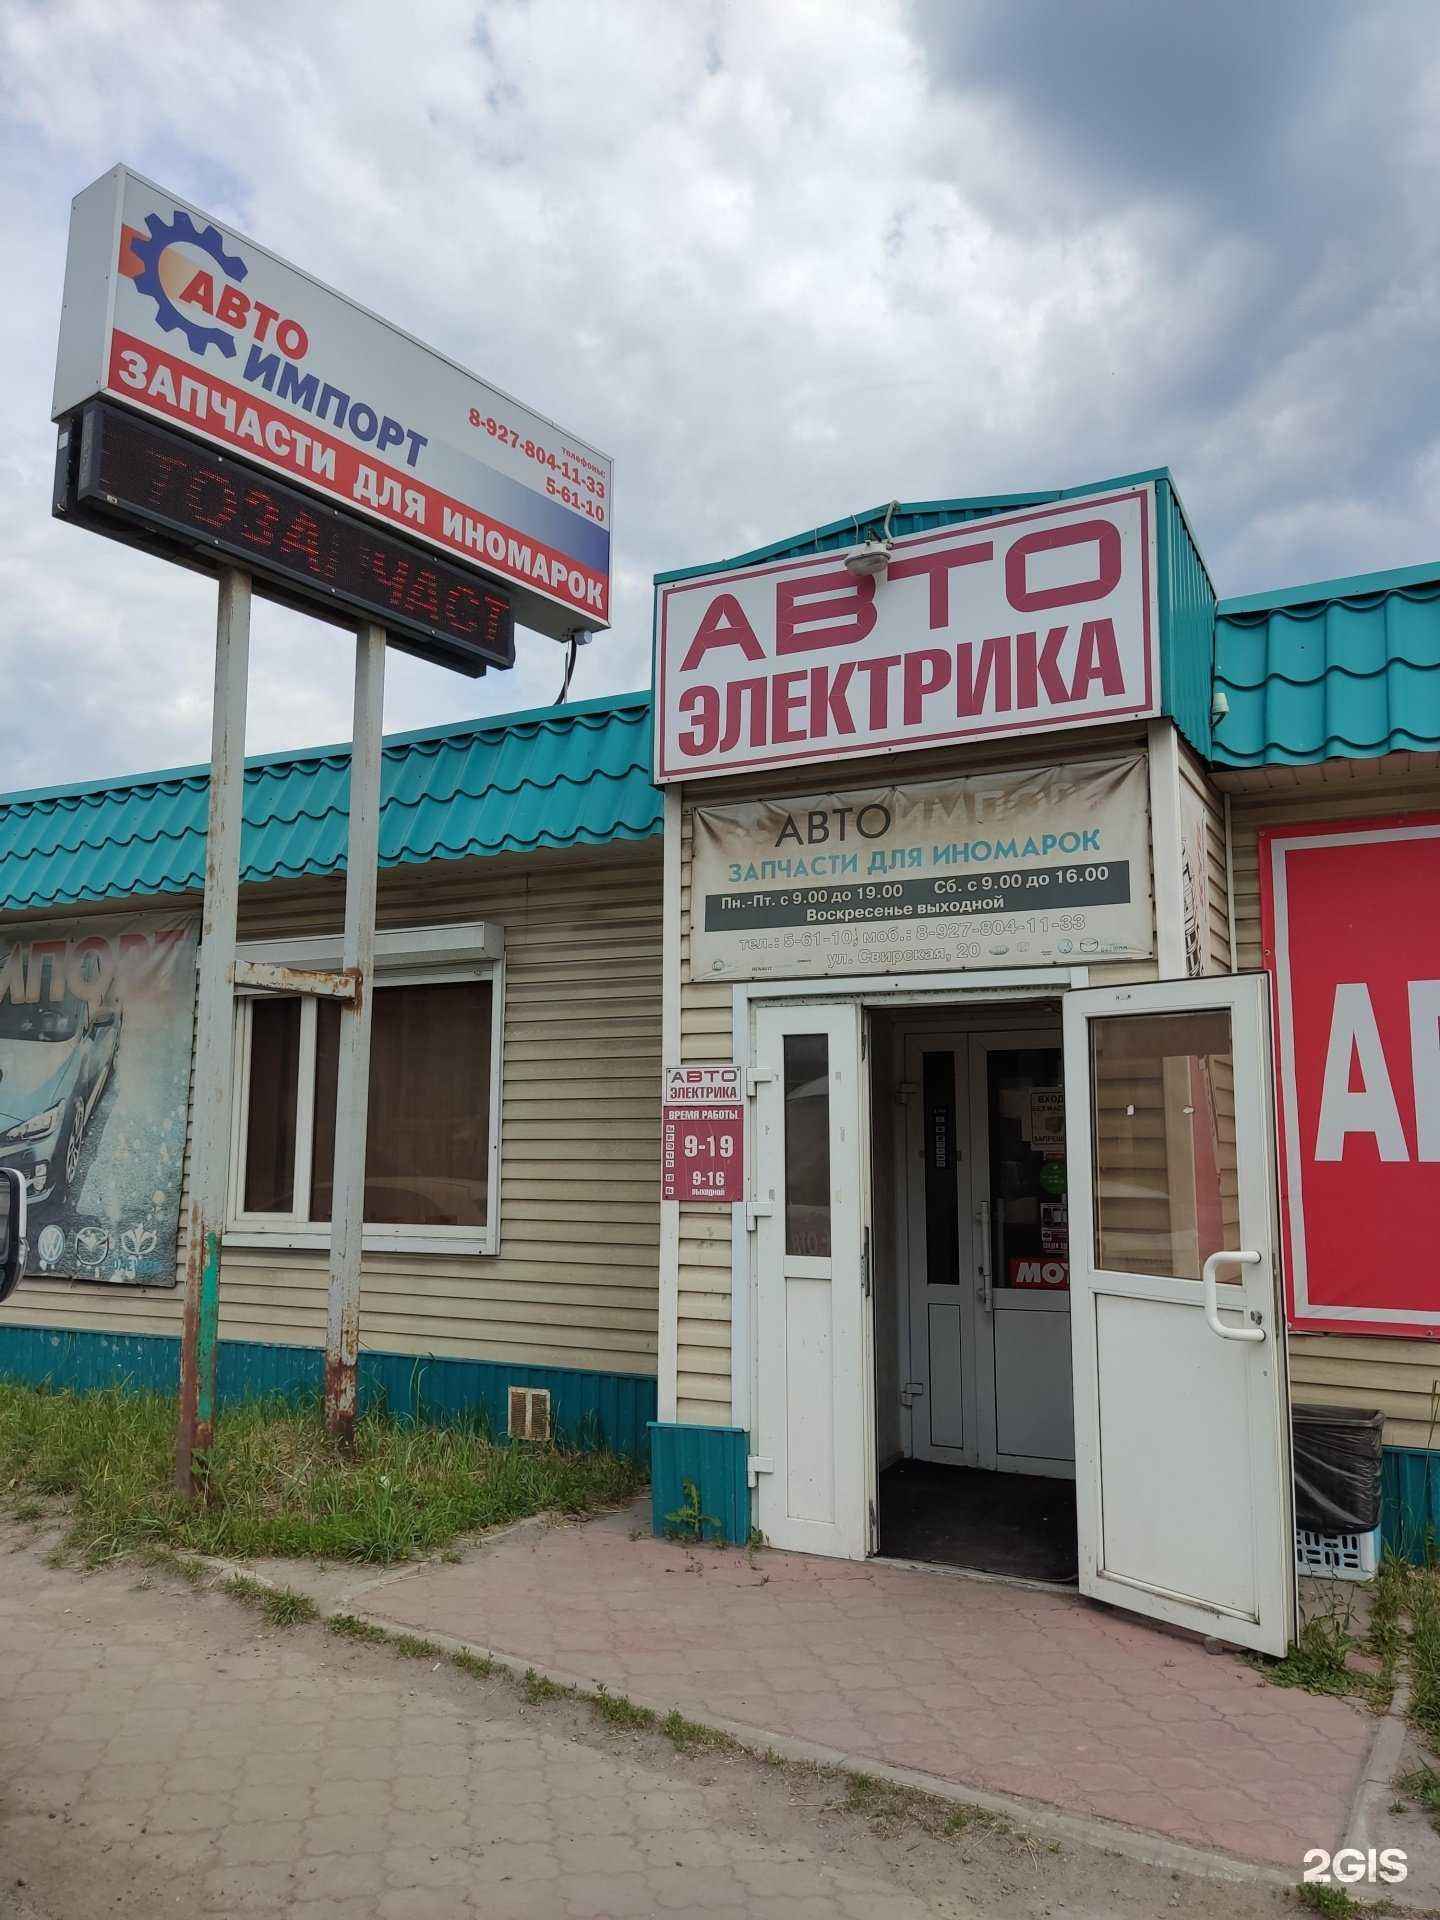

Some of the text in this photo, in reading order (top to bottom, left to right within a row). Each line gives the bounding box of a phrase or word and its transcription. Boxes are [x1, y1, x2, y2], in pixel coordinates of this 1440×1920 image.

[179, 271, 309, 360] АВТО
[243, 343, 428, 467] ИМПОРТ
[468, 408, 605, 499] 8-927-804-11-33
[119, 350, 604, 611] ЗАПЧАСТИ ДЛЯ ИНОМАРОК
[546, 477, 604, 522] 5-61-10
[680, 519, 1122, 672] АВТО
[678, 618, 1126, 757] ЭЛЕКТРИКА
[775, 804, 891, 847] АВТО
[728, 828, 1101, 883] ЗАПЧАСТИ ДЛЯ ИНОМАРОК
[721, 866, 1109, 910] Пн.-Пт. с 9.00 до 19.00 Сб. с 9.00 до 16.00
[806, 895, 1005, 924] Воскресенье выходной
[739, 936, 780, 951] тел.:
[863, 926, 911, 944] моб.:
[916, 914, 1086, 941] 8-927-804-11-33
[827, 952, 853, 968] ул.
[956, 943, 981, 959] 20
[670, 1086, 737, 1099] ЭЛЕКТРИКА
[671, 1070, 737, 1083] АВТО
[669, 1110, 738, 1120] ВРЕМЯ РАБОТЫ
[684, 1135, 734, 1158] 9-19
[692, 1171, 725, 1186] 9-16
